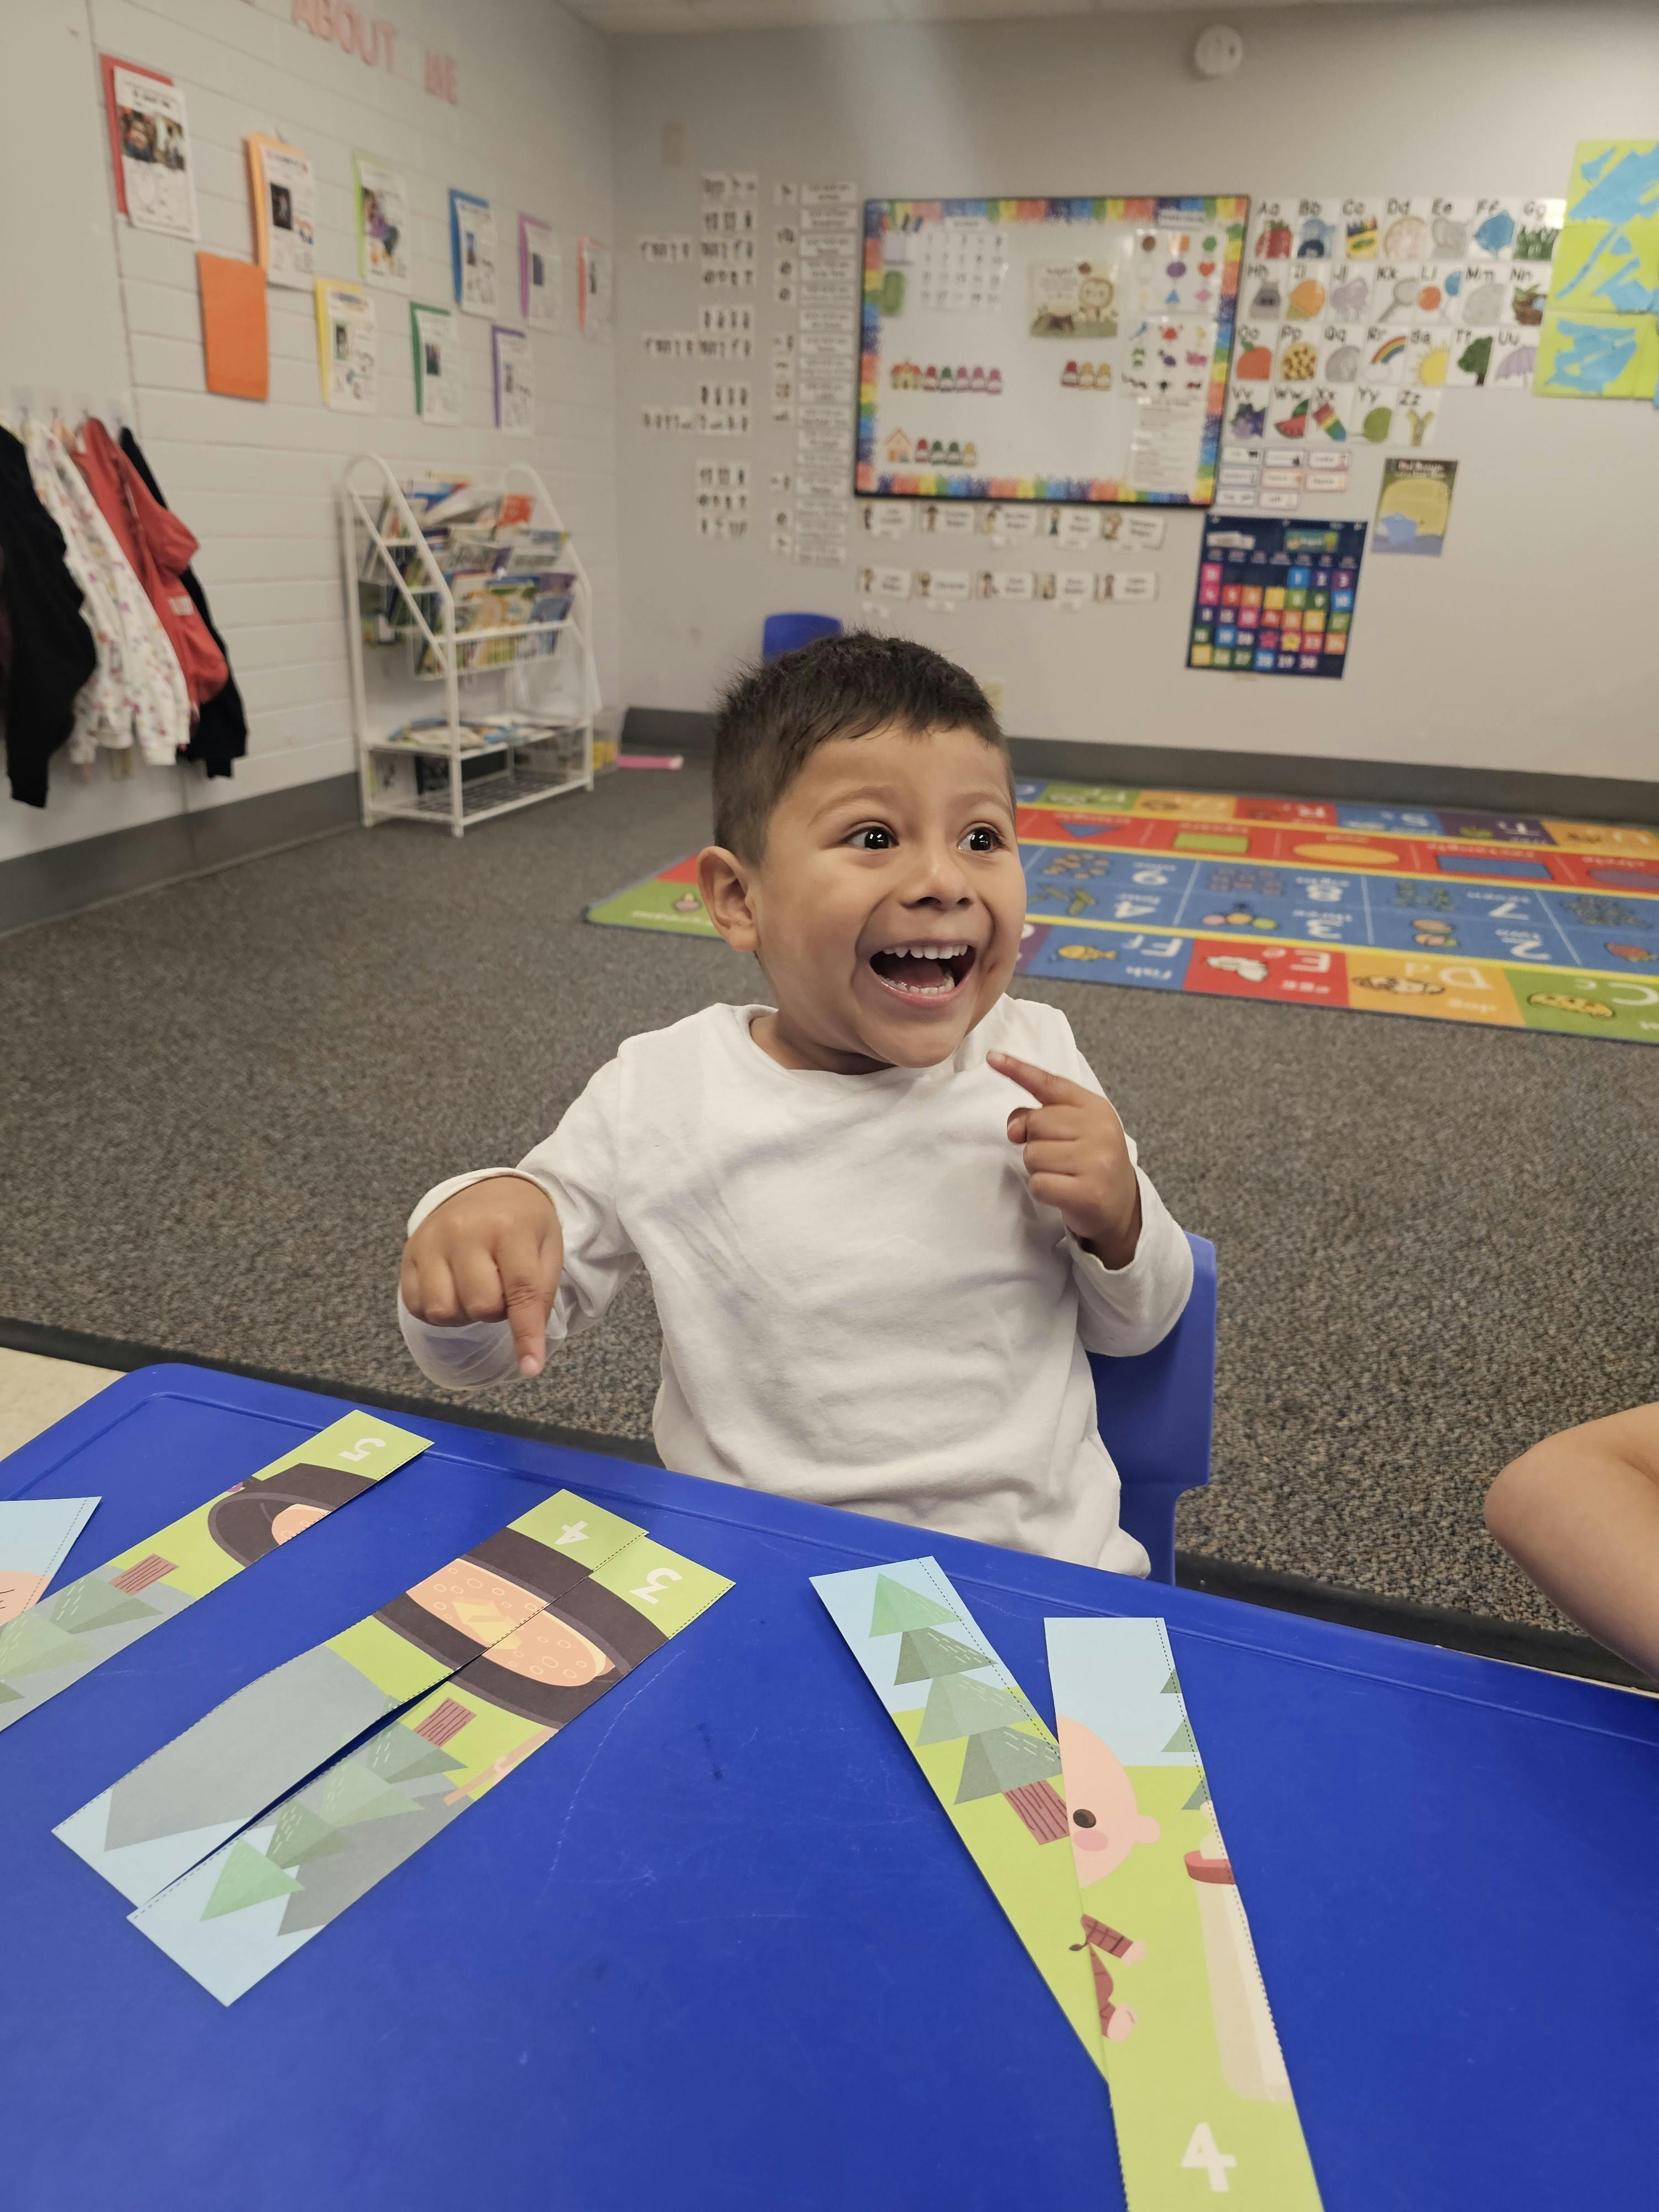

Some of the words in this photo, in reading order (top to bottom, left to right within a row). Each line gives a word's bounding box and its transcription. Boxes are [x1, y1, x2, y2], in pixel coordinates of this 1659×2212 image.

[291, 0, 397, 74] ABOUT
[425, 49, 459, 105] ME
[1258, 199, 1280, 215] Aa
[1298, 199, 1322, 215] Bb
[1342, 199, 1364, 215] Cc
[1387, 199, 1411, 215] Dd
[1431, 199, 1452, 215] Ee
[1524, 201, 1546, 218] Gg
[1247, 264, 1269, 277] Hh
[1378, 265, 1396, 278] Kk
[1466, 265, 1493, 279] Mm
[1511, 267, 1533, 280] Nn
[1238, 327, 1259, 340] Oo
[1280, 328, 1302, 342] Pp
[1324, 328, 1345, 343] Qq
[1366, 328, 1386, 341] Rr
[1498, 330, 1520, 345] Uu
[1232, 387, 1253, 400] Vv
[1274, 388, 1303, 401] Ww
[1358, 390, 1379, 404] Yy
[1399, 392, 1421, 405] Zz
[1426, 842, 1537, 859] rectangle
[1582, 855, 1646, 869] circle
[1132, 870, 1168, 885] 9
[1117, 892, 1161, 905] four
[1305, 883, 1344, 902] 8
[1466, 891, 1531, 904] seven
[1113, 900, 1156, 919] 4
[1292, 907, 1354, 923] three
[1488, 902, 1529, 921] 7
[1305, 917, 1344, 940] 3
[1495, 928, 1541, 942] two
[1122, 935, 1145, 951] f
[1139, 938, 1185, 958] F
[1510, 938, 1551, 961] 2
[1261, 946, 1288, 959] e
[1288, 949, 1331, 974] E
[1404, 961, 1432, 977] d
[1439, 966, 1493, 990] D
[1280, 979, 1331, 994] egg
[1608, 982, 1658, 1006] C
[1448, 997, 1497, 1013] dog
[337, 1437, 387, 1462] 5
[554, 1519, 590, 1545] 4
[629, 1567, 684, 1605] 3
[1181, 2121, 1238, 2194] 4
